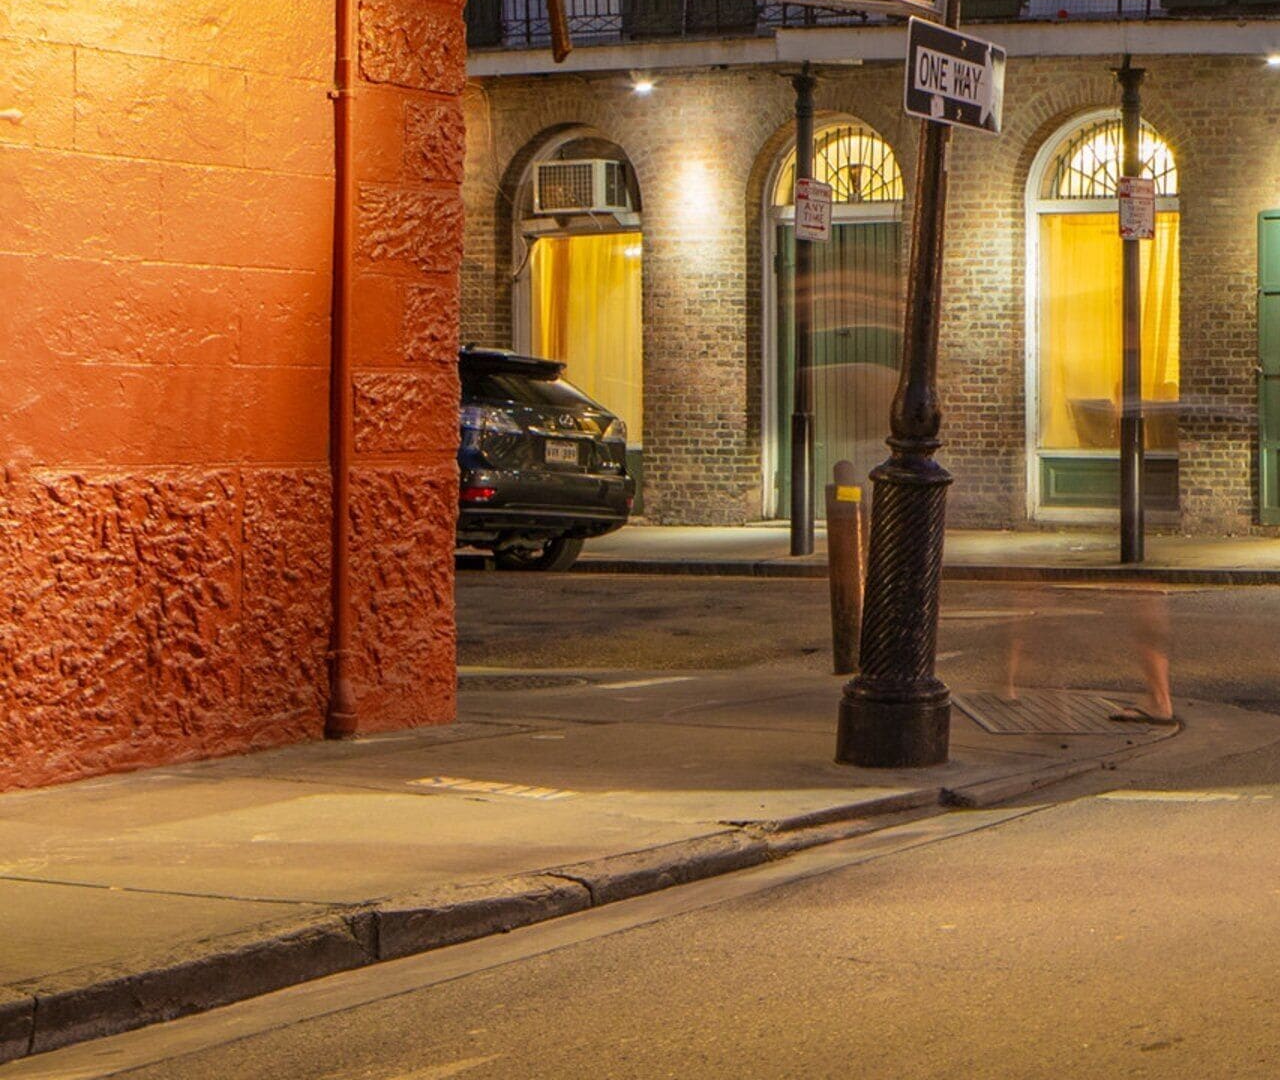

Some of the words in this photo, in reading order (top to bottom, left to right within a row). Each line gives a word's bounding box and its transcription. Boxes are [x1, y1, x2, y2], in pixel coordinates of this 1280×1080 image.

[919, 52, 949, 92] ONE
[953, 61, 982, 100] WAY
[804, 201, 825, 212] ANY
